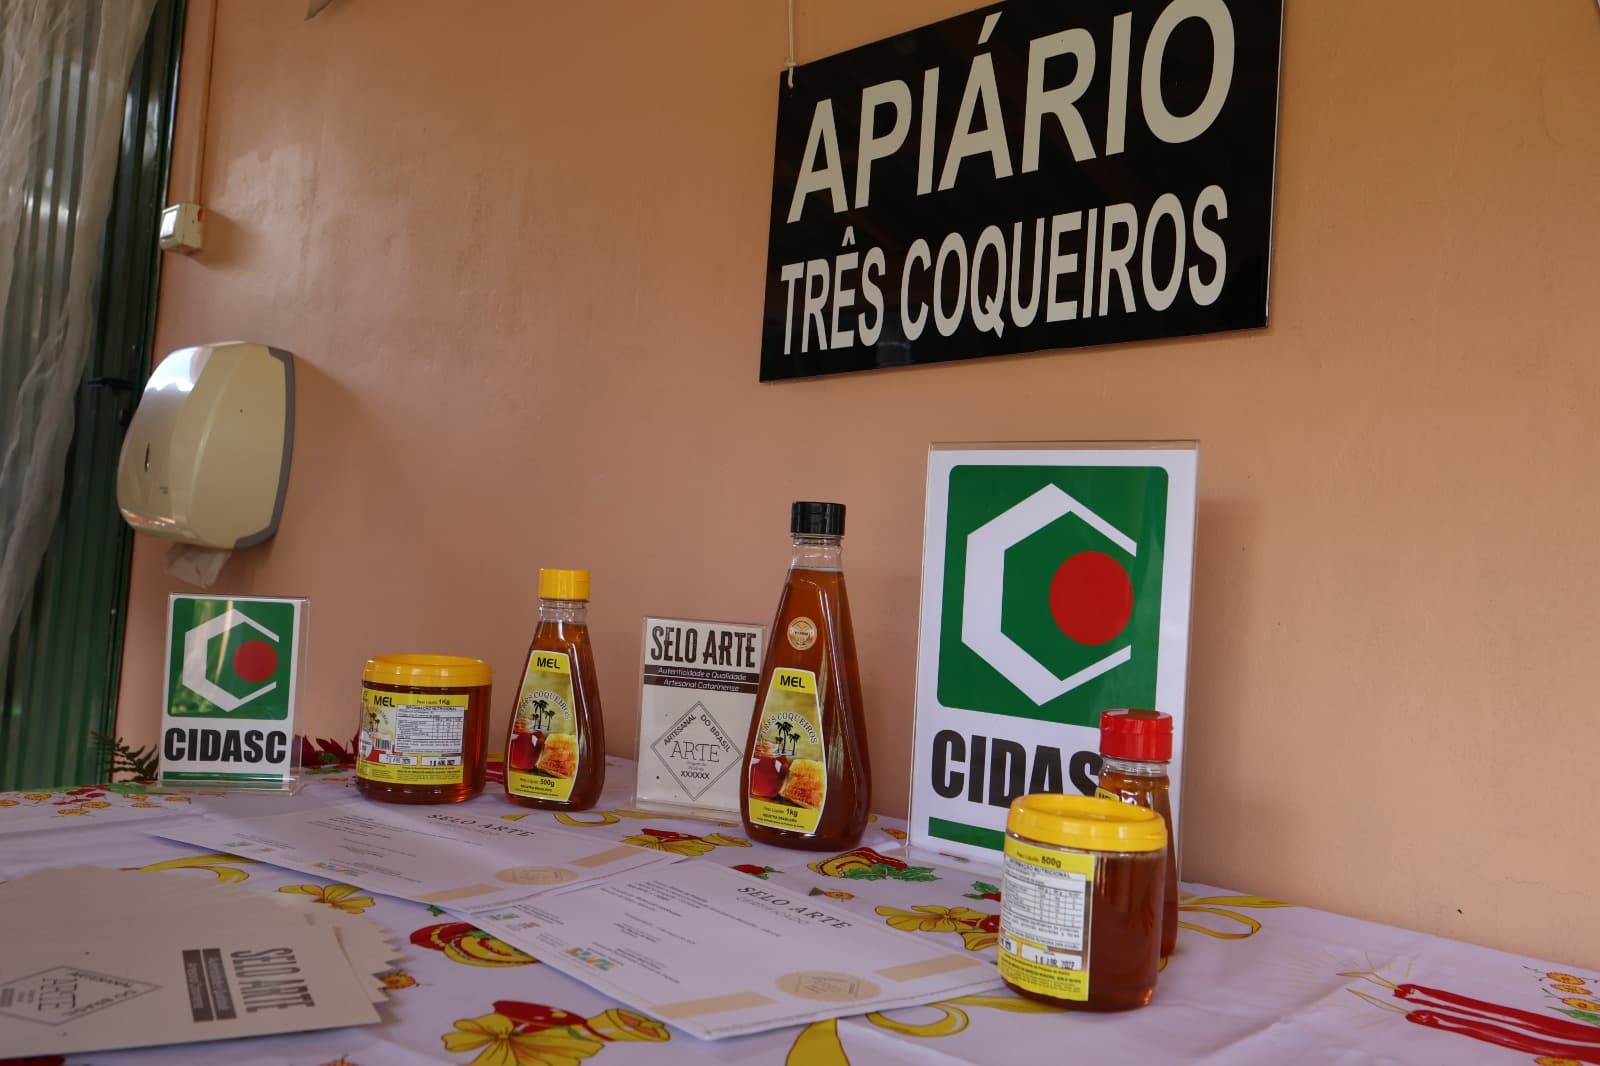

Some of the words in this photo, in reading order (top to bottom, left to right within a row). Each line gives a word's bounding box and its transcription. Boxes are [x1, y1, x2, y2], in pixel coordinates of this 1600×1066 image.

[787, 0, 1235, 224] APIÁRIO
[781, 225, 886, 355] TRÊS
[900, 184, 1228, 340] COQUEIROS
[650, 626, 697, 663] SELO
[703, 630, 757, 668] ARTE
[537, 657, 561, 669] MEL
[711, 671, 747, 681] Qualidade
[664, 679, 697, 688] Artesanal
[697, 681, 740, 692] Catarinense
[780, 674, 806, 689] MEL
[373, 695, 395, 707] MEL
[664, 714, 697, 745] ARTESANAL
[700, 714, 711, 727] DO
[710, 726, 731, 753] BRASIL
[777, 712, 818, 744] COQUEIROS
[164, 728, 287, 764] CIDASC
[669, 740, 721, 762] ARTE
[540, 778, 555, 788] 500g
[931, 729, 1103, 809] CIDAS
[427, 813, 476, 825] SELO
[477, 823, 535, 837] ARTE
[786, 808, 798, 818] 1kg
[1041, 855, 1062, 869] 500g
[737, 887, 791, 906] SELO
[788, 907, 854, 929] ARTE
[230, 947, 301, 978] SELO
[238, 979, 315, 1013] ARTE
